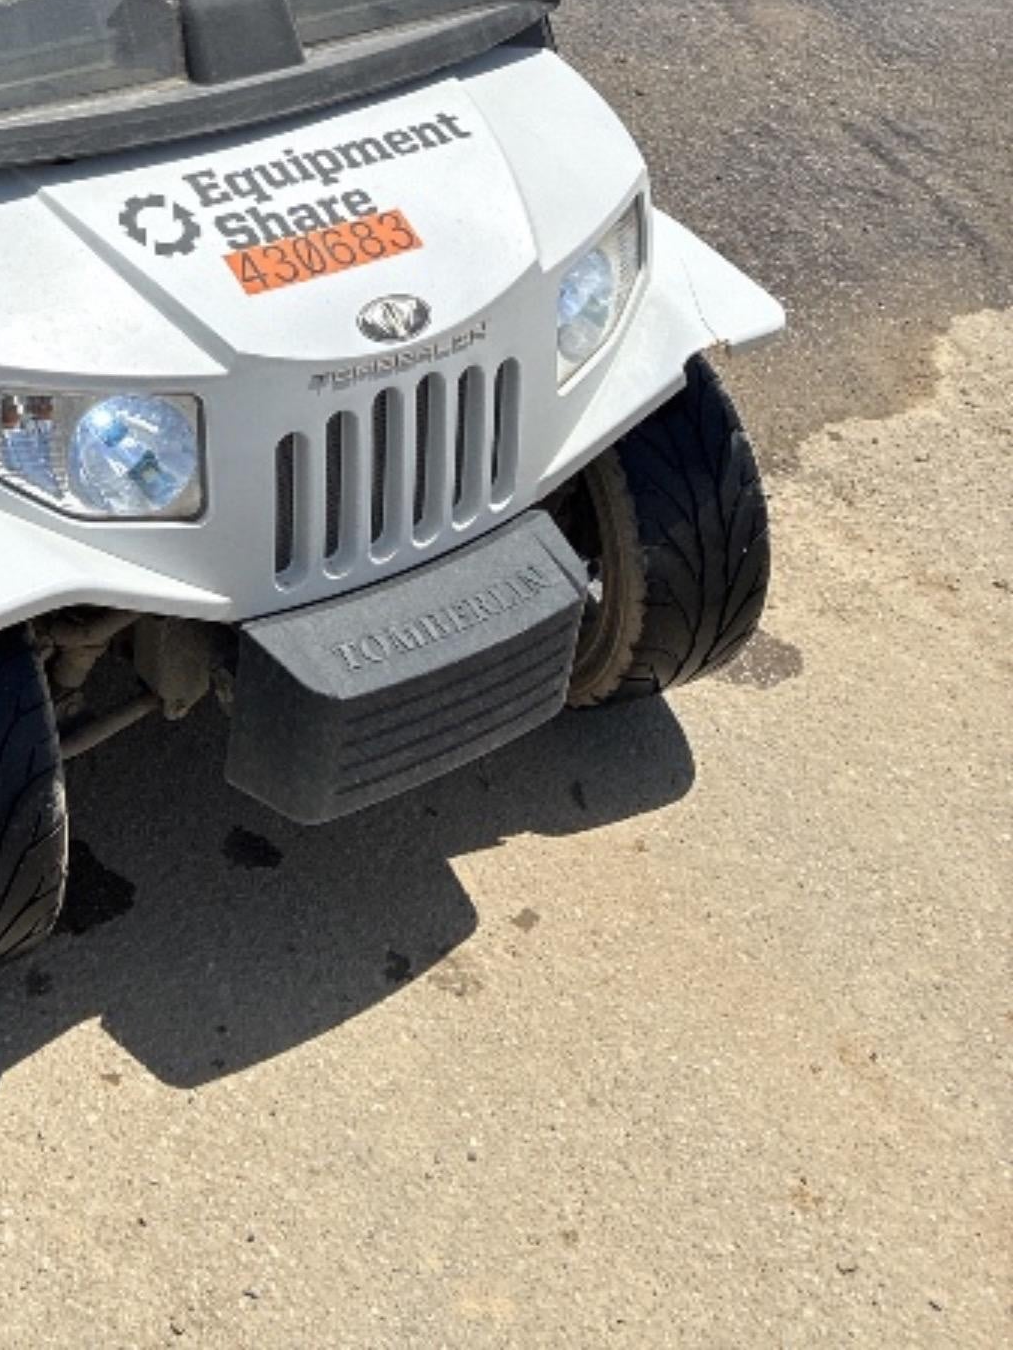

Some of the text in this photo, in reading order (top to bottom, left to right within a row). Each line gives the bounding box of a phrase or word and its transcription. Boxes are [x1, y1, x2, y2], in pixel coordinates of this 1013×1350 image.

[182, 111, 473, 207] Equipment
[214, 188, 379, 251] Share
[240, 211, 415, 288] 430683
